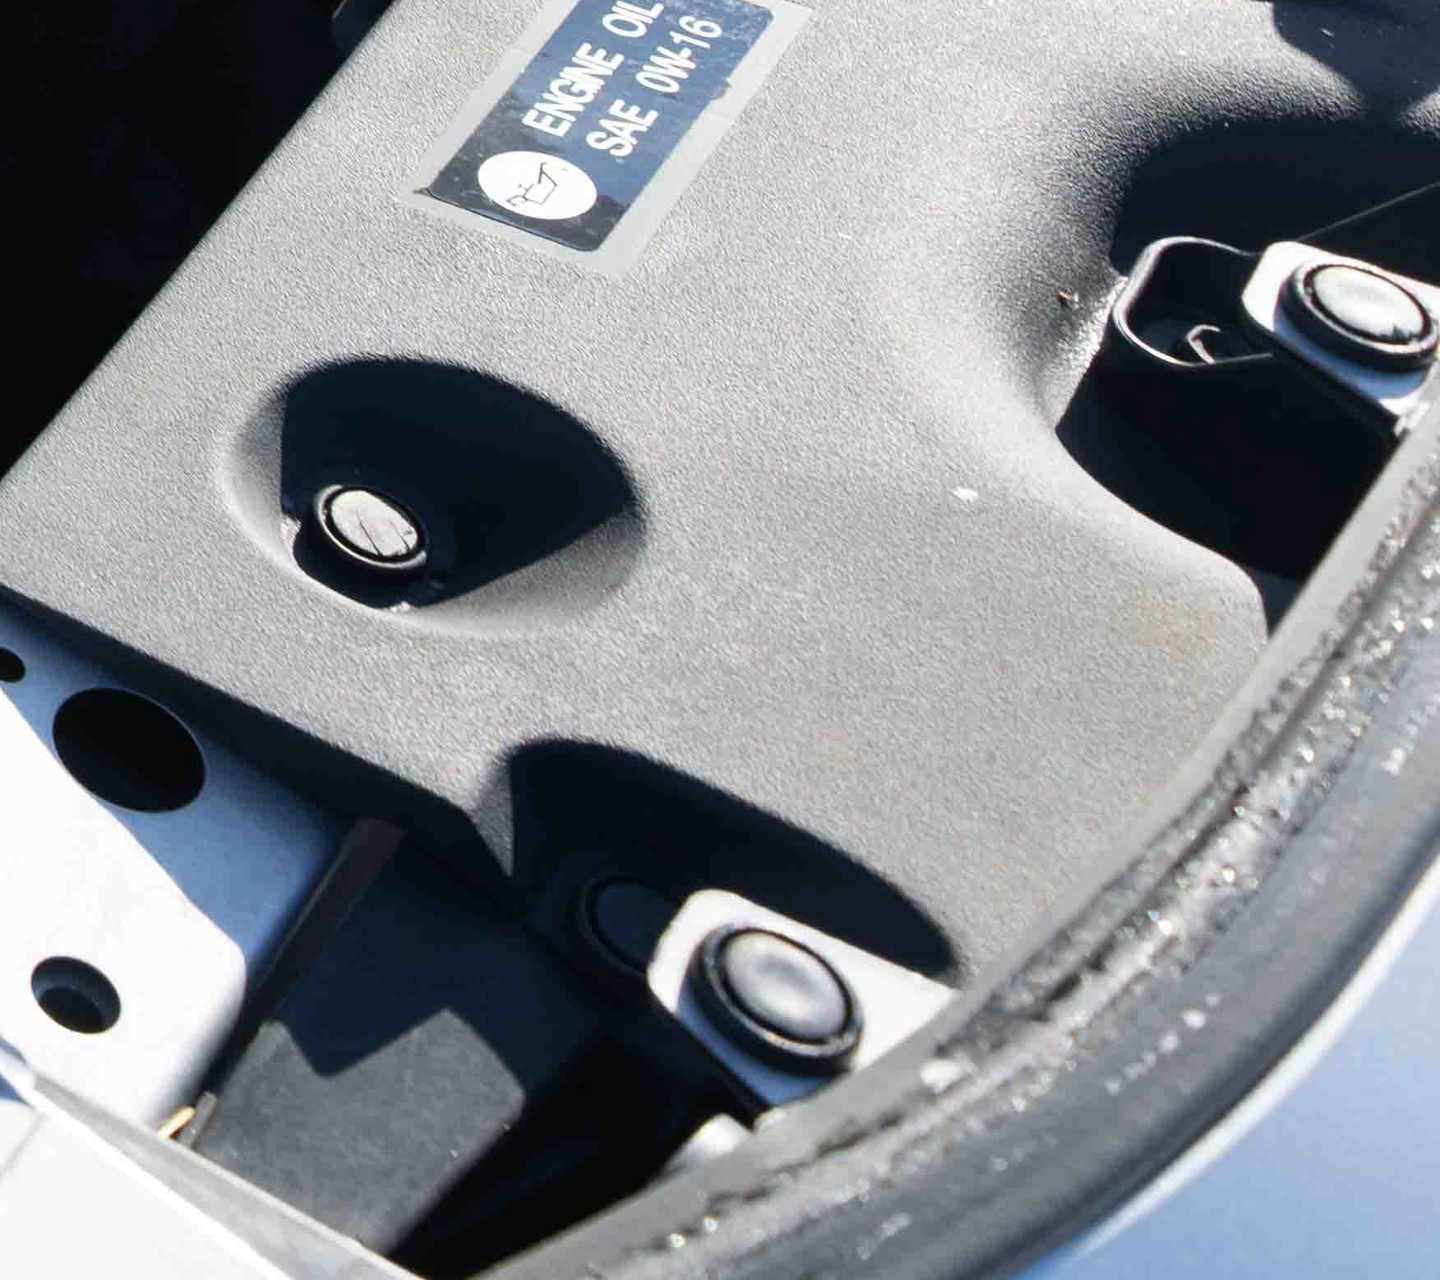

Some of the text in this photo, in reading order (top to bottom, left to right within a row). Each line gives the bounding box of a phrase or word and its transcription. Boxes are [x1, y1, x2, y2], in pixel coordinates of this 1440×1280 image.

[520, 0, 665, 138] ENGINE OIL
[585, 14, 724, 158] SAE 0W-16
